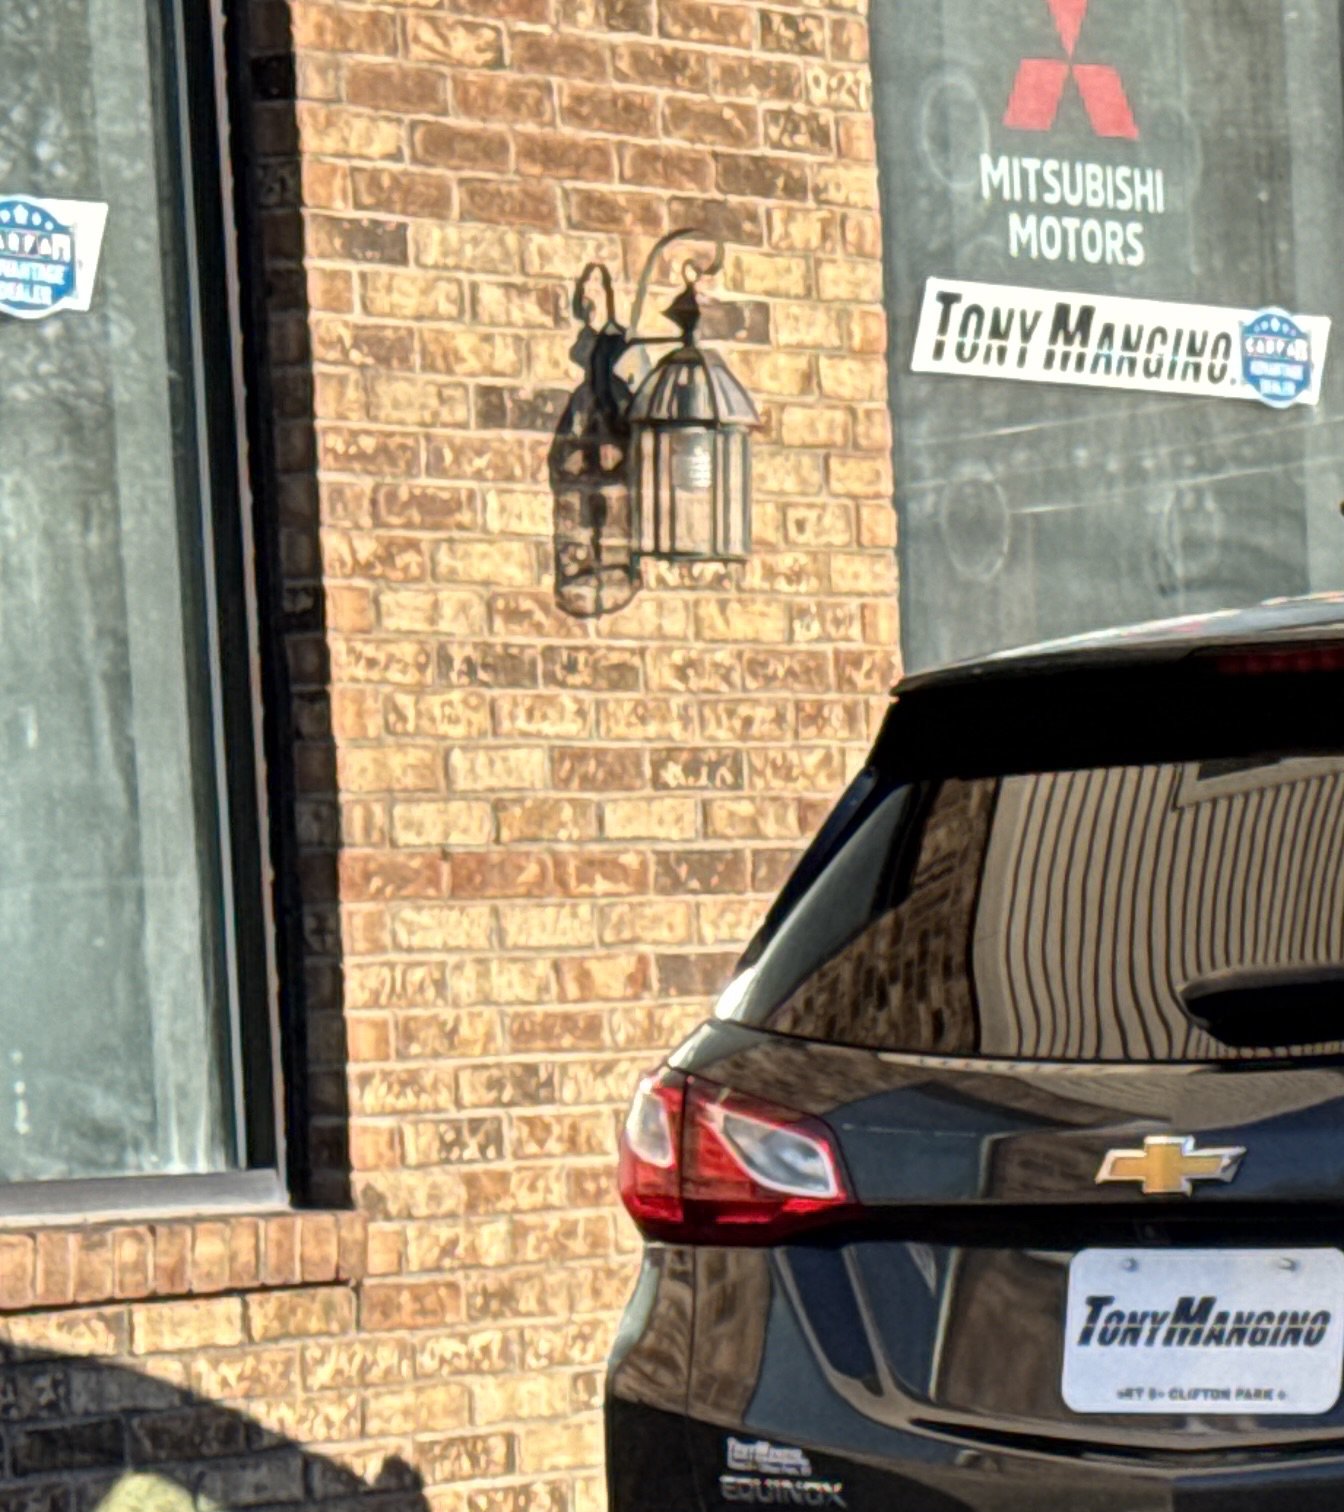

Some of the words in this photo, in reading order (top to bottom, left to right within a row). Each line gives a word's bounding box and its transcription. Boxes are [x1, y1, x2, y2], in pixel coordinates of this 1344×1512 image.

[979, 153, 1165, 214] MITSUBISHI
[1008, 212, 1145, 267] MOTORS
[719, 1474, 848, 1510] EQUINOX
